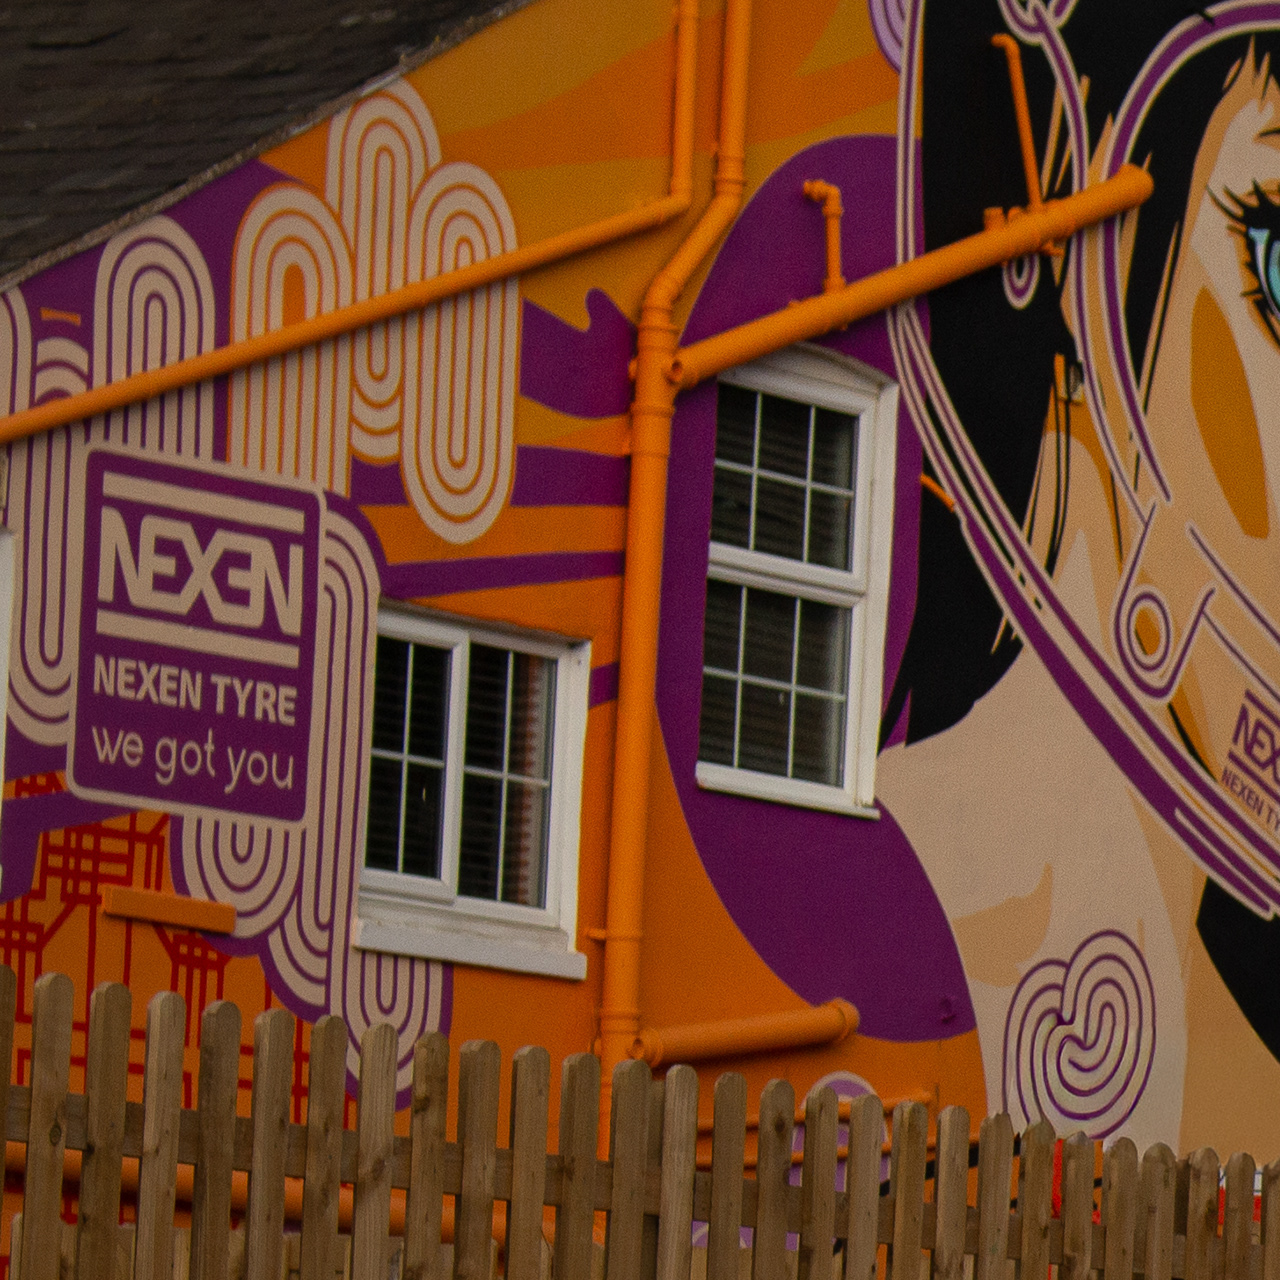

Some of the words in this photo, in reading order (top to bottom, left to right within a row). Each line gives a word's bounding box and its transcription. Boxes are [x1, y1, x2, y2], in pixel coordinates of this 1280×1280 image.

[98, 504, 304, 638] NEXEN
[93, 653, 202, 711] NEXEN
[210, 672, 297, 727] TYRE
[92, 725, 144, 767] we
[154, 726, 216, 786] got
[223, 745, 294, 794] you
[1221, 766, 1264, 817] NEXEN
